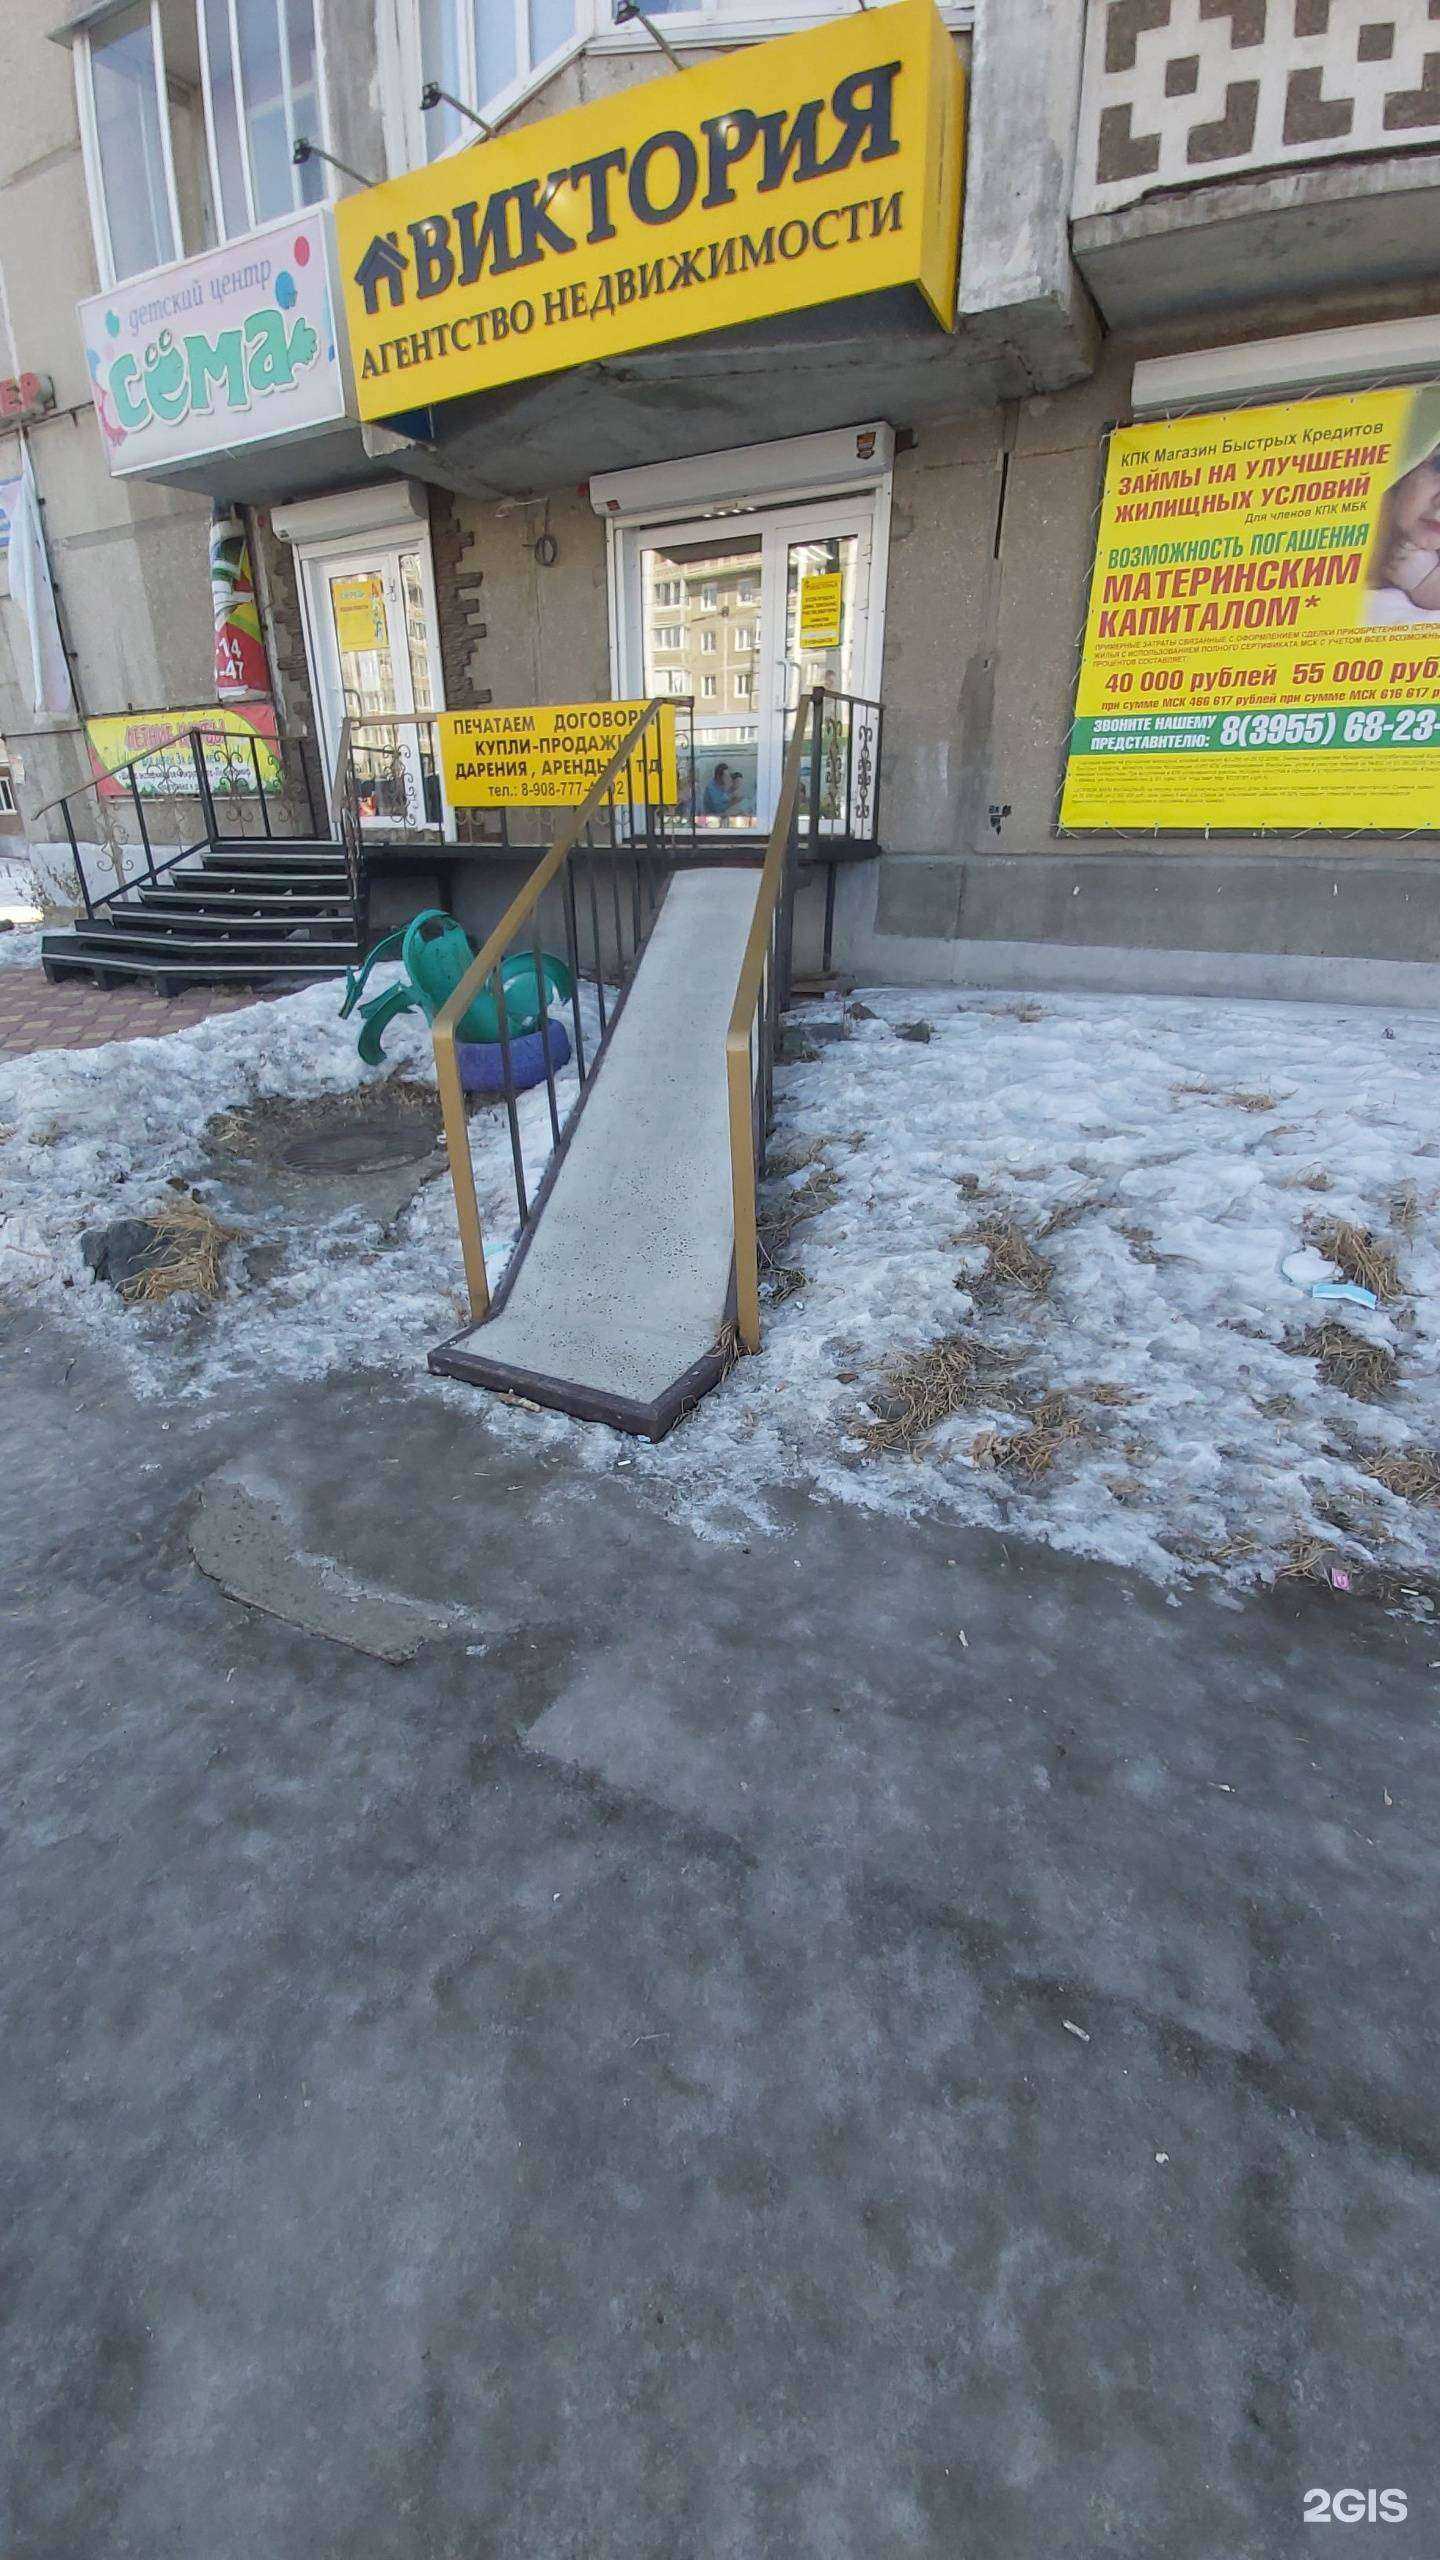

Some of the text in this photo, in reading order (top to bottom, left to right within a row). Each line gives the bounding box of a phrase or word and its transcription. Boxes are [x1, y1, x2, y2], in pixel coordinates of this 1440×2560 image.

[407, 60, 902, 299] ВИКТОРИЯ
[128, 260, 272, 336] детский центр
[360, 191, 904, 381] АГЕНТСТВО НЕДВИЖИМОСТИ
[1121, 423, 1383, 467] КПК Магазин Быстрых Кредитов
[1118, 443, 1392, 496] ЗАЙМЫ НА УЛУЧШЕНИЕ
[1114, 473, 1371, 523] ЖИЛИЩНЫХ УСЛОВИЙ
[1244, 500, 1368, 525] Для членов КПК МБК
[1107, 523, 1370, 569] ВОЗМОЖНОСТЬ ПОГАШЕНИЯ
[1102, 552, 1362, 604] МАТЕРИНСКИМ
[1105, 666, 1277, 693] 40 000 рублей
[1292, 656, 1440, 684] 55 000 руб
[1101, 701, 1120, 712] при
[1122, 700, 1159, 711] сумме
[1162, 697, 1186, 708] МСК
[1213, 695, 1233, 706] 617
[1236, 693, 1277, 706] рублей
[1280, 694, 1301, 704] при
[1304, 692, 1346, 704] сумме
[1349, 689, 1377, 700] МСК
[1406, 687, 1430, 699] 617
[453, 715, 536, 735] ПЕЧАТАЕМ
[1093, 715, 1217, 733] ЗВОНИТЕ НАШЕМУ
[1220, 712, 1336, 746] 8(3955)
[1090, 734, 1211, 751] ПРЕДСТАВИТЕЛЮ:
[488, 785, 518, 798] тел.:
